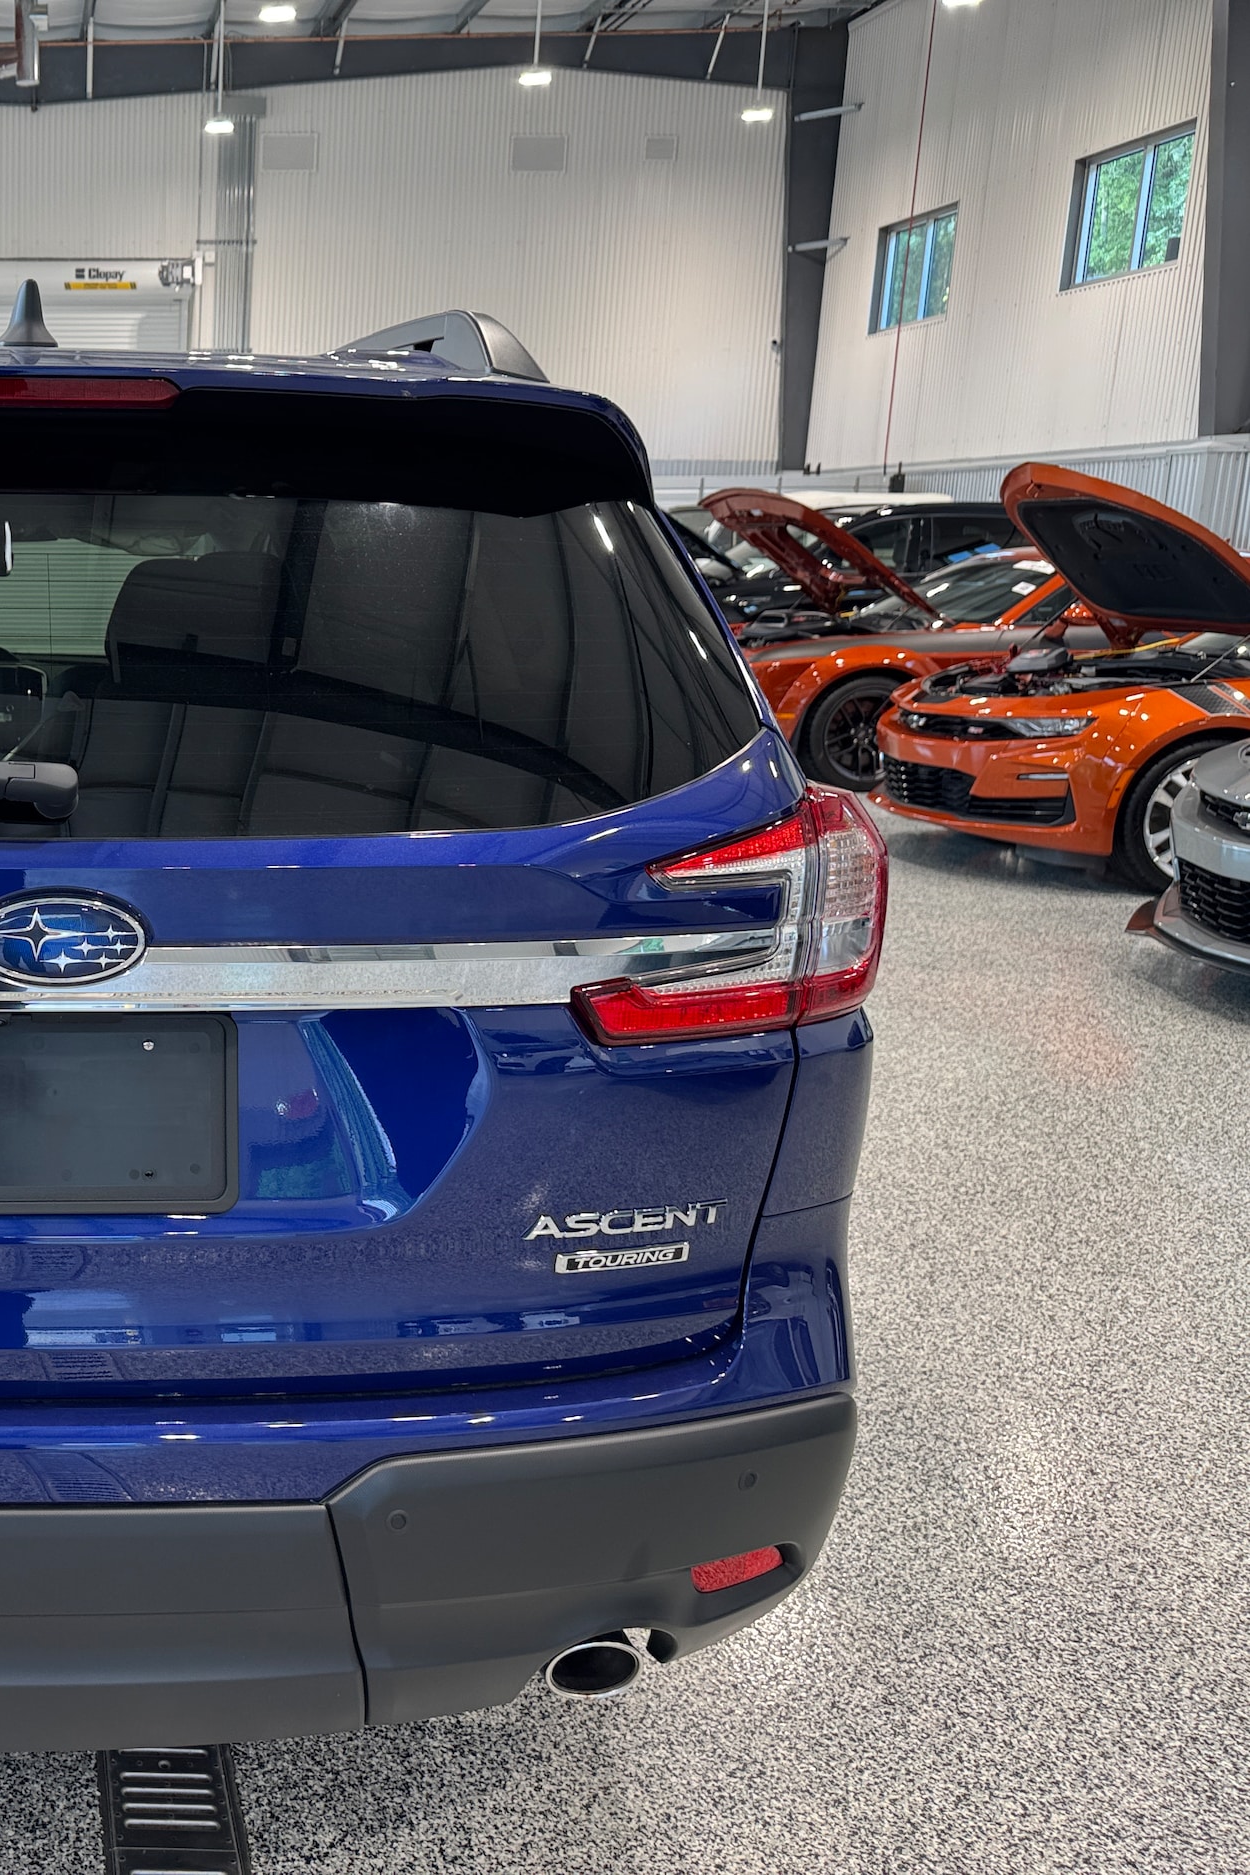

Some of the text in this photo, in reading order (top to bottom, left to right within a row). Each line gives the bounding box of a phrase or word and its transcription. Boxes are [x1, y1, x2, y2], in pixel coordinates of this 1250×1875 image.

[87, 268, 124, 281] Clopay
[521, 1198, 728, 1241] ASCENT
[574, 1249, 676, 1270] TOURING
